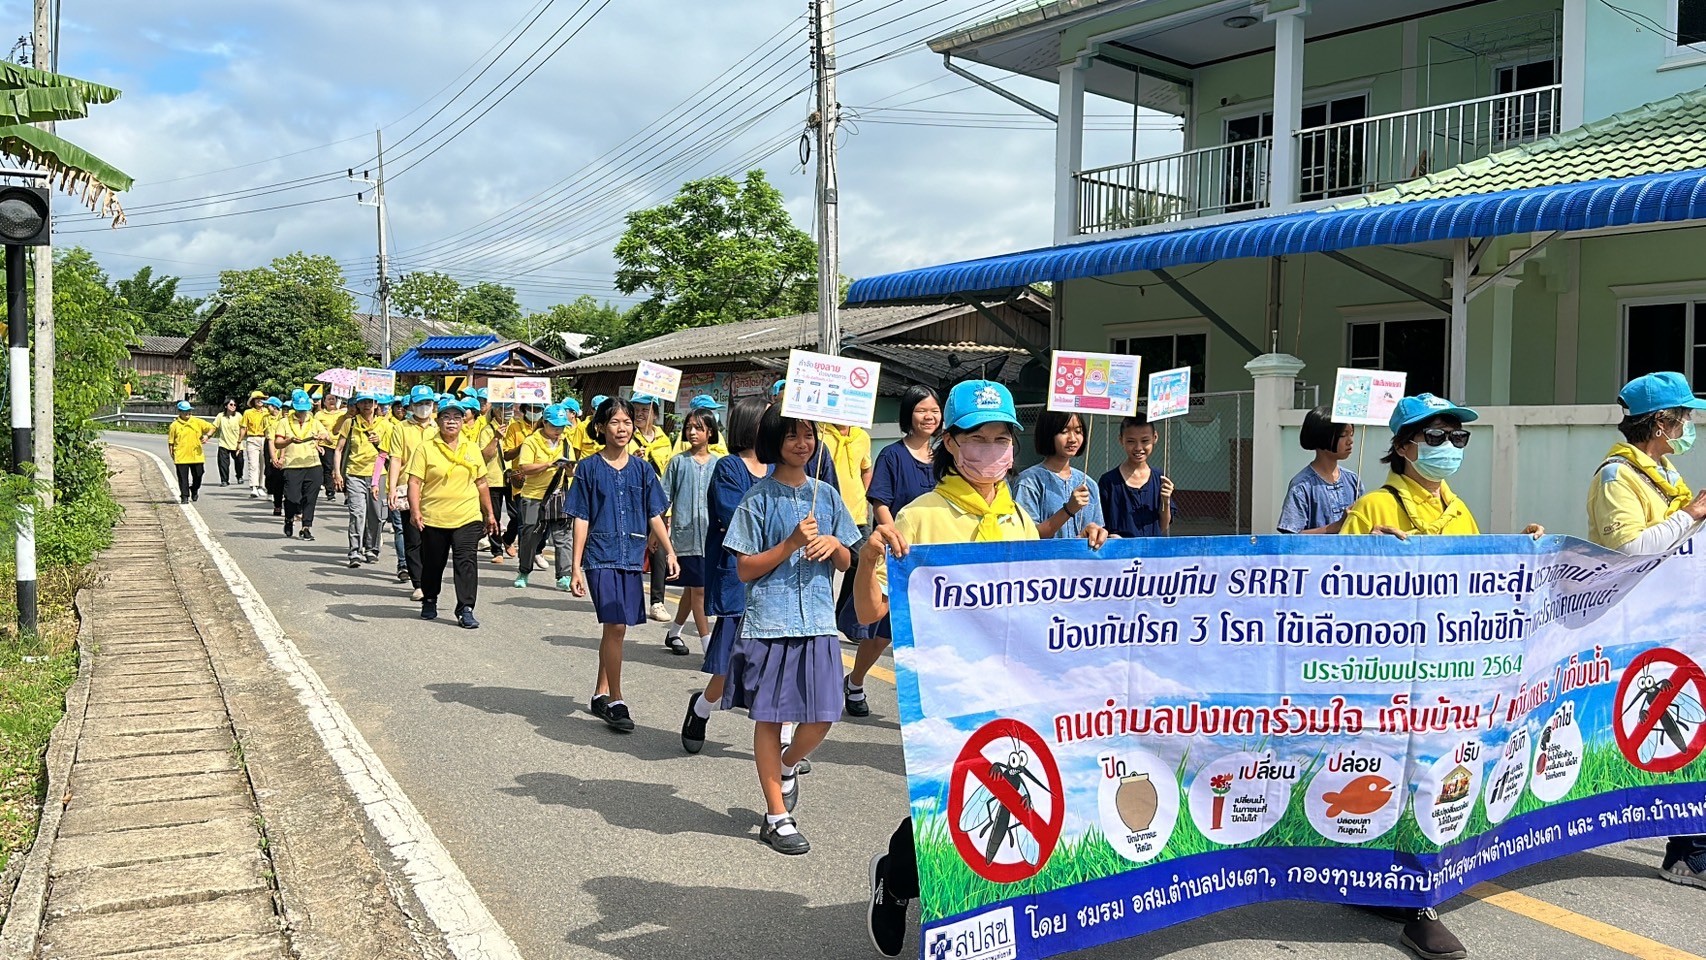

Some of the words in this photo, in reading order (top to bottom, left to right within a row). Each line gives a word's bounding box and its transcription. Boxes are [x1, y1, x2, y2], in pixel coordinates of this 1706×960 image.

[814, 361, 841, 373] ยุงลาย
[934, 558, 1217, 608] โครงการอบรมฟื้นฟูทีม
[1229, 567, 1308, 597] SRRT
[1321, 564, 1459, 598] ตำบลปงเตา
[1049, 613, 1178, 650] ป้องกันโรค
[1190, 616, 1207, 643] 3
[1220, 611, 1264, 643] โรค
[1304, 654, 1475, 681] ประจำปีงบประมาณ
[1482, 653, 1523, 678] 2564
[1055, 696, 1362, 742] คนตำบลปงเตาร่วมใจ
[1379, 694, 1480, 732] เก็บบ้าน
[1562, 645, 1610, 692] เก็บน้ำ
[1328, 750, 1381, 773] ปล่อย
[1455, 741, 1480, 764] ปรับ
[1101, 755, 1126, 779] ปิด
[1239, 753, 1295, 780] เปลี่ยน
[1336, 816, 1371, 826] ปล่อยปลา
[1337, 823, 1368, 835] กินลูกน้ำ
[1025, 904, 1067, 939] โดย
[1077, 897, 1124, 928] ชมรม
[1133, 866, 1276, 914] อสม.ตำบลปงเตา,
[1286, 822, 1562, 897] กองทุนหลักประกันสุขภาพตำบลปงเตา
[1568, 815, 1594, 837] และ
[1599, 795, 1706, 829] รพ.สต.บ้านพ
[955, 918, 1011, 957] สปสช.
